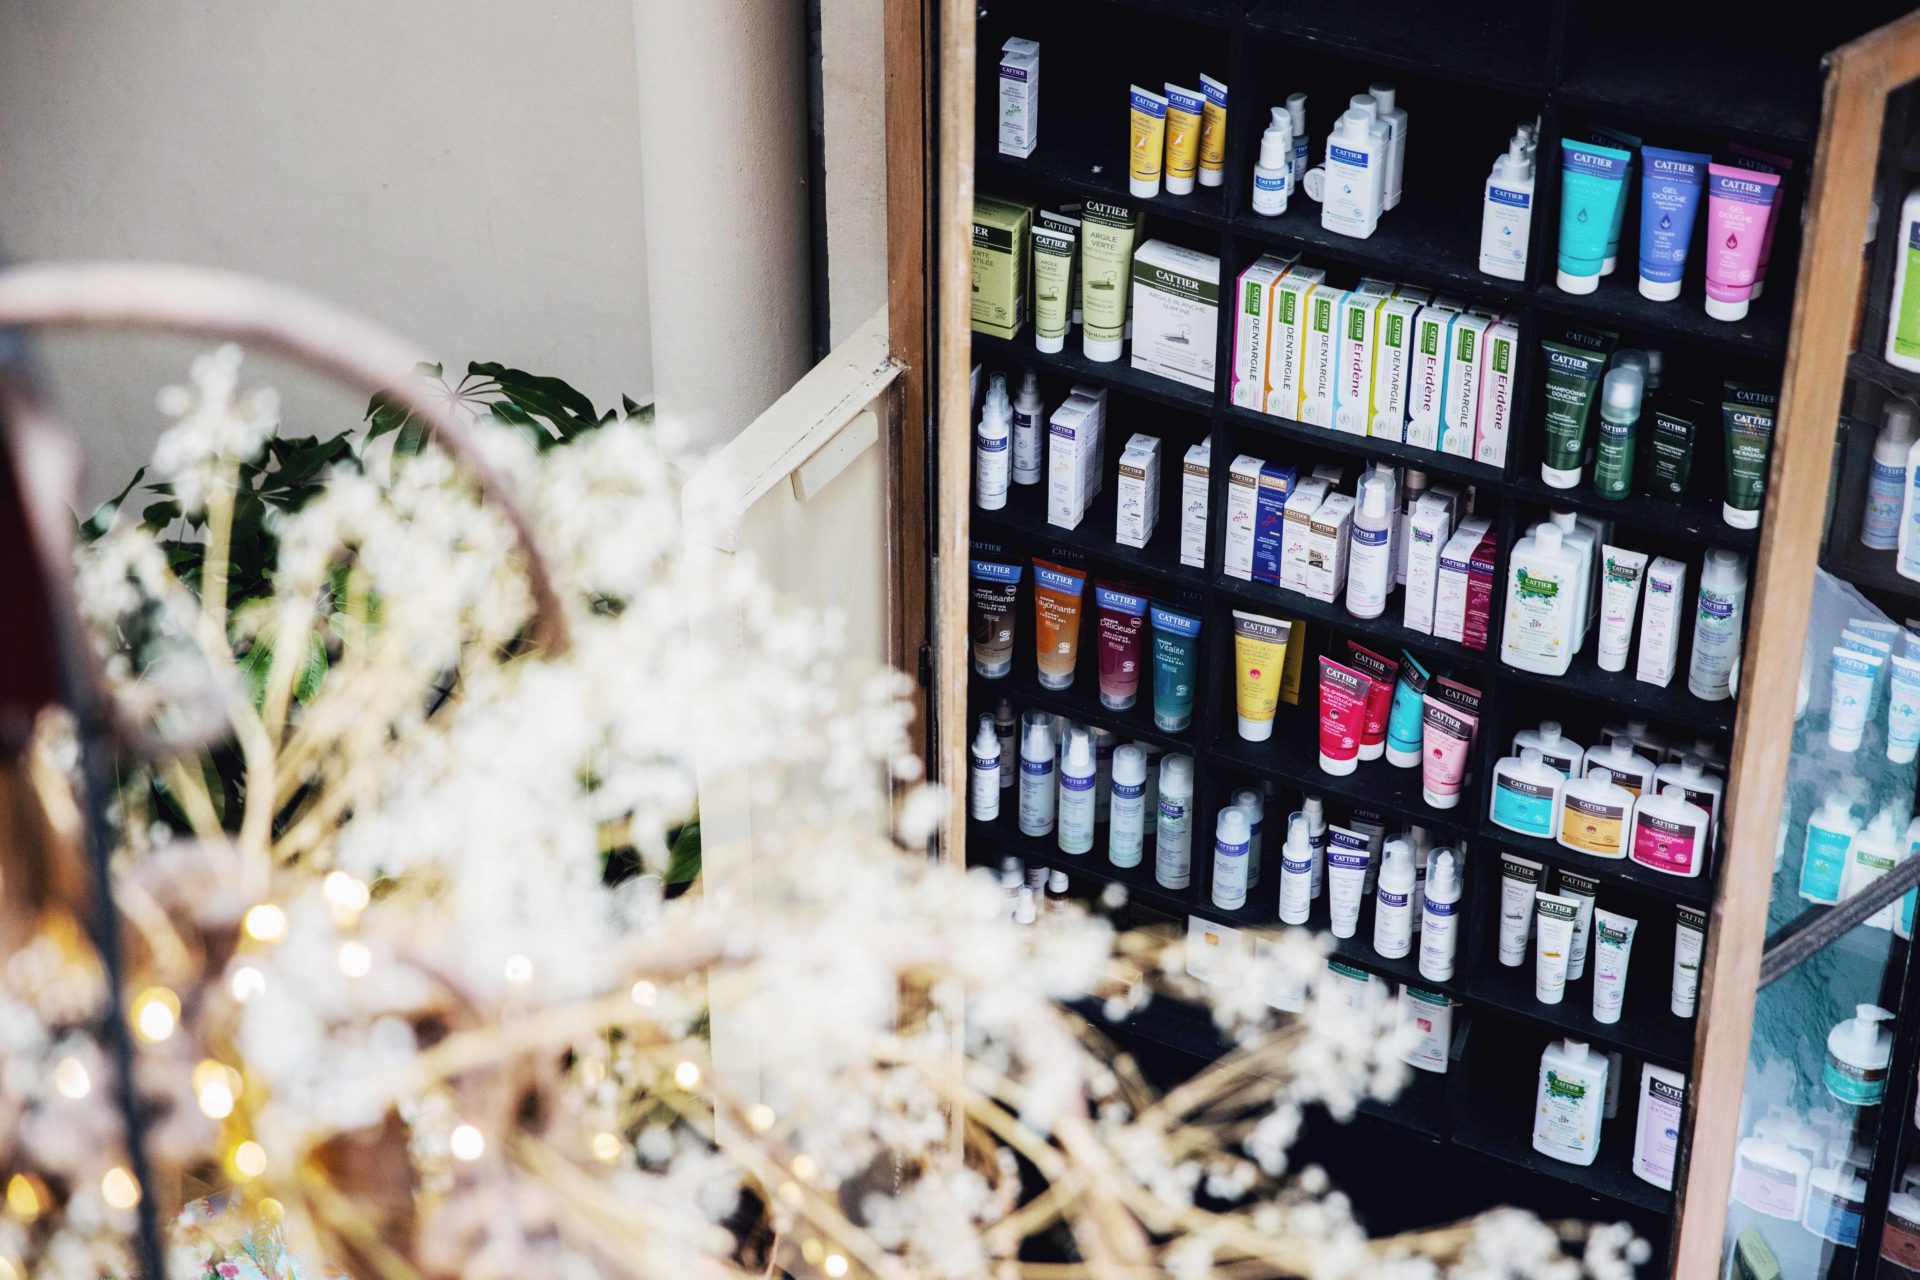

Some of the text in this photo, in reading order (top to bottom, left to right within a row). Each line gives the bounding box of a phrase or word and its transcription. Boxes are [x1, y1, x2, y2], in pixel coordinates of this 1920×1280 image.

[1002, 66, 1025, 76] CATTIER
[1203, 84, 1225, 100] CATTIER
[1135, 95, 1159, 110] CATTIER
[1170, 93, 1197, 107] CATTIER
[1335, 148, 1363, 160] CATTIER
[1573, 152, 1613, 169] CATTIER
[1654, 160, 1695, 174] CATTIER
[1258, 178, 1281, 186] CATTIER
[1721, 179, 1762, 194] CATTIER
[1494, 189, 1524, 200] CATTIER
[1662, 186, 1678, 195] GEL
[1652, 192, 1687, 203] DOUCHE
[1086, 200, 1129, 218] CATTIER
[1728, 205, 1744, 214] GEL
[1718, 211, 1753, 223] DOUCHE
[1043, 220, 1074, 234] CATTIER
[1035, 236, 1067, 248] CATTIER
[1090, 232, 1117, 243] ARGILE
[1091, 241, 1115, 250] VERTE
[972, 250, 990, 258] ERTE
[972, 257, 994, 267] NTILÉE
[1156, 269, 1199, 290] CATTIER
[1148, 291, 1207, 314] ARGILE BLANCHE
[1252, 286, 1260, 313] CATTIER
[1163, 303, 1190, 316] SURFINE
[1286, 295, 1295, 325] CATTIER
[1321, 303, 1329, 330] CATTIER
[1355, 312, 1364, 338] CATTIER
[1392, 318, 1401, 345] CATTIER
[1428, 326, 1437, 353] CATTIER
[1566, 331, 1602, 347] CATTIER
[1249, 318, 1260, 381] DENTARGILE
[1465, 332, 1474, 360] CATTIER
[1283, 327, 1295, 390] DENTARGILE
[1500, 344, 1509, 370] CATTIER
[1551, 353, 1588, 369] CATTIER
[1318, 335, 1329, 398] DENTARGILE
[1351, 342, 1364, 398] Eridène
[1389, 350, 1401, 413] DENTARGILE
[1423, 356, 1437, 412] Eridène
[1460, 364, 1473, 428] DENTARGILE
[1546, 382, 1587, 398] SHAMPOOING
[1551, 391, 1578, 402] DOUCHE
[1494, 374, 1508, 430] Eridène
[1052, 424, 1073, 434] CATTIER
[1600, 421, 1628, 433] CATTIER
[1657, 419, 1687, 433] CATTIER
[1739, 445, 1761, 453] CRÈME
[1120, 465, 1143, 475] CATTIER
[1185, 463, 1208, 473] CATTIER
[1231, 473, 1254, 483] CATTIER
[1286, 510, 1308, 519] CATTIER
[1312, 522, 1334, 532] CATTIER
[977, 563, 1010, 575] CATTIER
[1442, 558, 1466, 569] CATTIER
[1471, 560, 1495, 570] CATTIER
[1612, 565, 1634, 575] CATTIER
[1041, 571, 1073, 586] CATTIER
[1525, 578, 1552, 589] CATTIER
[975, 590, 1016, 603] enfaisante
[1104, 592, 1137, 606] CATTIER
[1703, 599, 1728, 610] CATTIER
[1158, 612, 1191, 628] CATTIER
[1243, 621, 1277, 634] CATTIER
[1159, 643, 1185, 656] Vitalité
[1354, 652, 1385, 672] CATTIER
[1400, 657, 1419, 681] CATTIER
[1326, 667, 1357, 686] CATTIER
[1445, 689, 1479, 706] CATTIER
[1430, 709, 1461, 729] CATTIER
[976, 758, 996, 766] ATTIER
[1021, 759, 1042, 769] ATTIER
[1062, 774, 1088, 785] CATTIER
[1612, 771, 1627, 780] TIER
[1115, 783, 1141, 793] CATTIER
[1510, 779, 1538, 792] CATTIER
[1579, 801, 1607, 813] CATTIER
[1354, 809, 1380, 819] CATTIER
[1651, 818, 1680, 830] CATTIER
[1334, 833, 1360, 846] CATTIER
[1645, 829, 1685, 844] SHAMPOOING
[1216, 840, 1240, 851] CATTIER
[1283, 858, 1306, 868] CATTIER
[1333, 854, 1361, 864] CATTIER
[1504, 862, 1535, 877] CATTIER
[1562, 875, 1593, 890] CATTIER
[1378, 888, 1403, 900] CATTIER
[1425, 897, 1451, 910] CATTIER
[1540, 901, 1572, 914] CATTIER
[1679, 910, 1705, 925] CATTIE
[1603, 927, 1624, 937] CATTIER
[1554, 1079, 1579, 1091] CATTIER
[1655, 1081, 1683, 1097] CATTI
